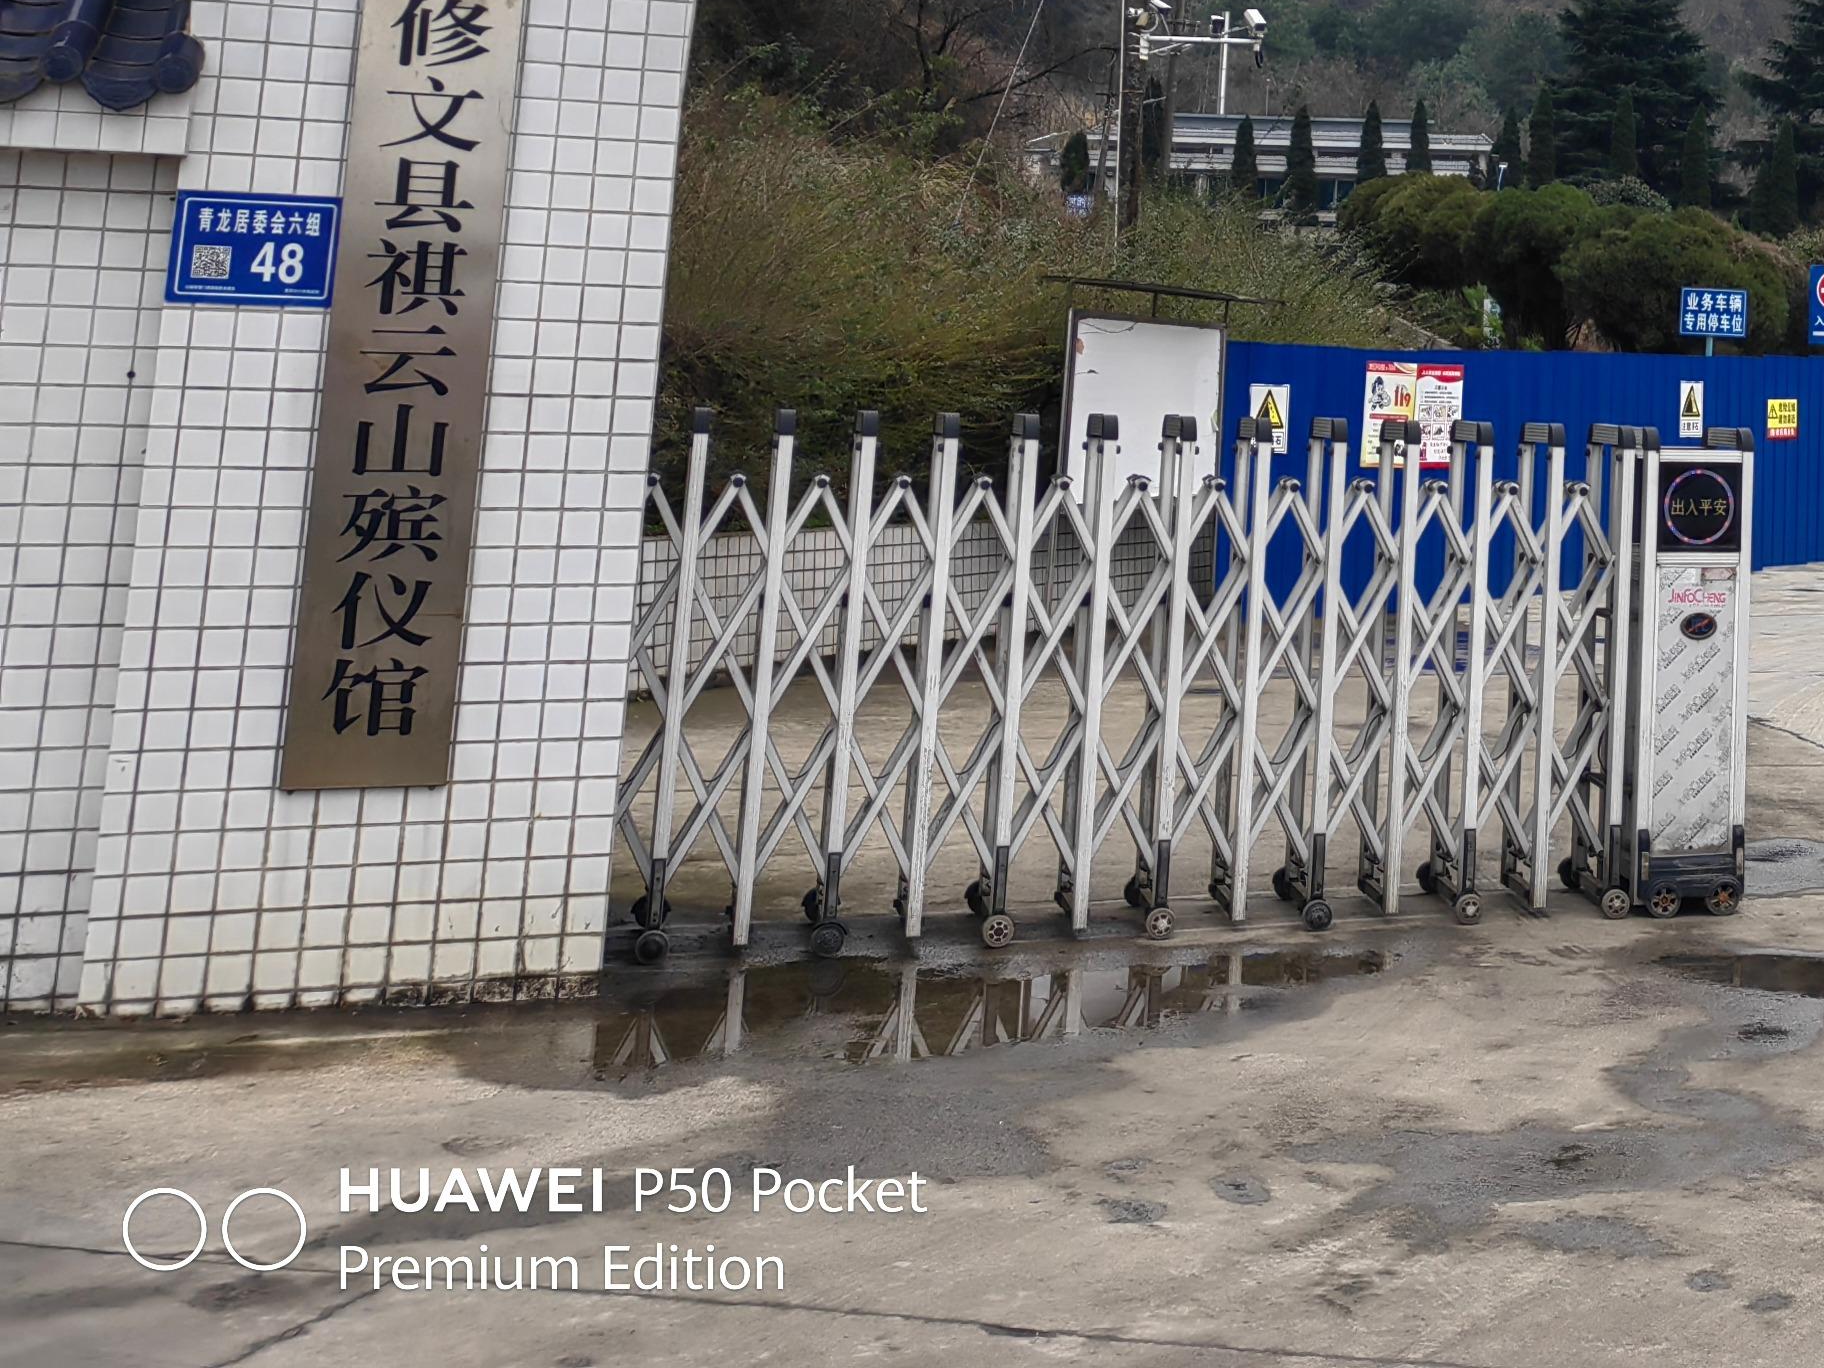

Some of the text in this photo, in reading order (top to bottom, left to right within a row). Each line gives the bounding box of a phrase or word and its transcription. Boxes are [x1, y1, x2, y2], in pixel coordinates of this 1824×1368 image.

[198, 207, 321, 237] 青龙居委会六组
[250, 241, 304, 285] 48
[1685, 292, 1743, 312] 业务车辆
[1683, 312, 1743, 332] 专用停车位
[1671, 498, 1727, 517] 出入平安
